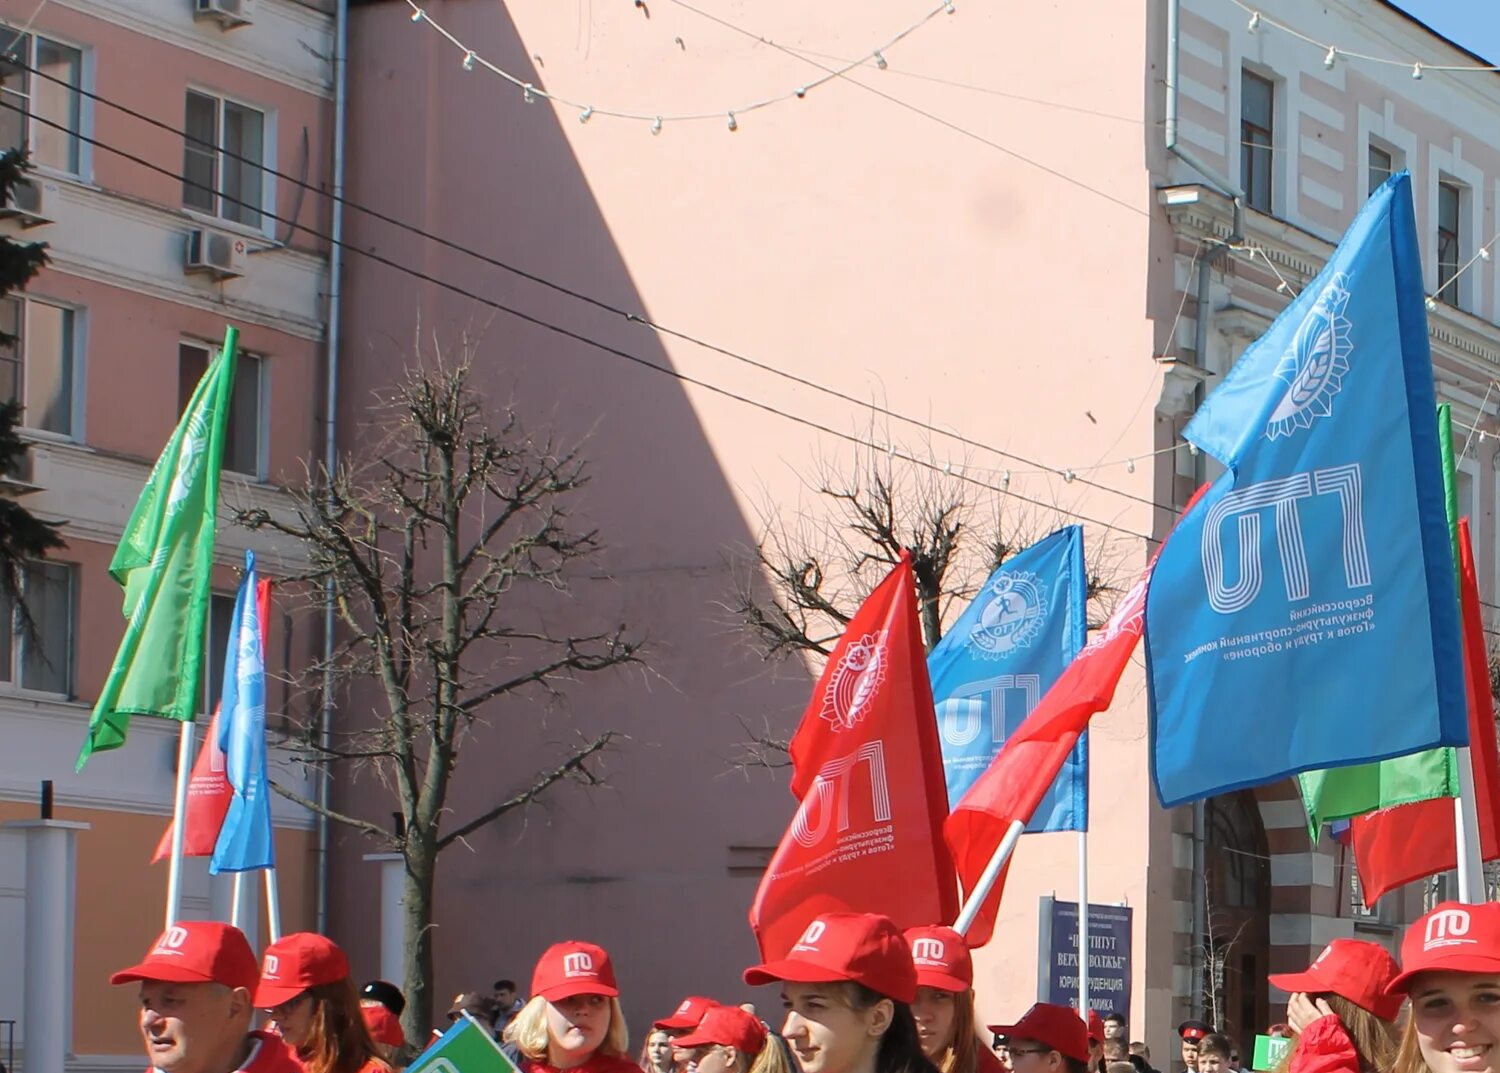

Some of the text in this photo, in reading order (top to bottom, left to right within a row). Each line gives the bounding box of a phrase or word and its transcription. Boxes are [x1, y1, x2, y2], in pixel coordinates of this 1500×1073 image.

[1425, 909, 1471, 943] ГТО
[912, 938, 945, 960] ГТО
[564, 952, 592, 972] ГТО
